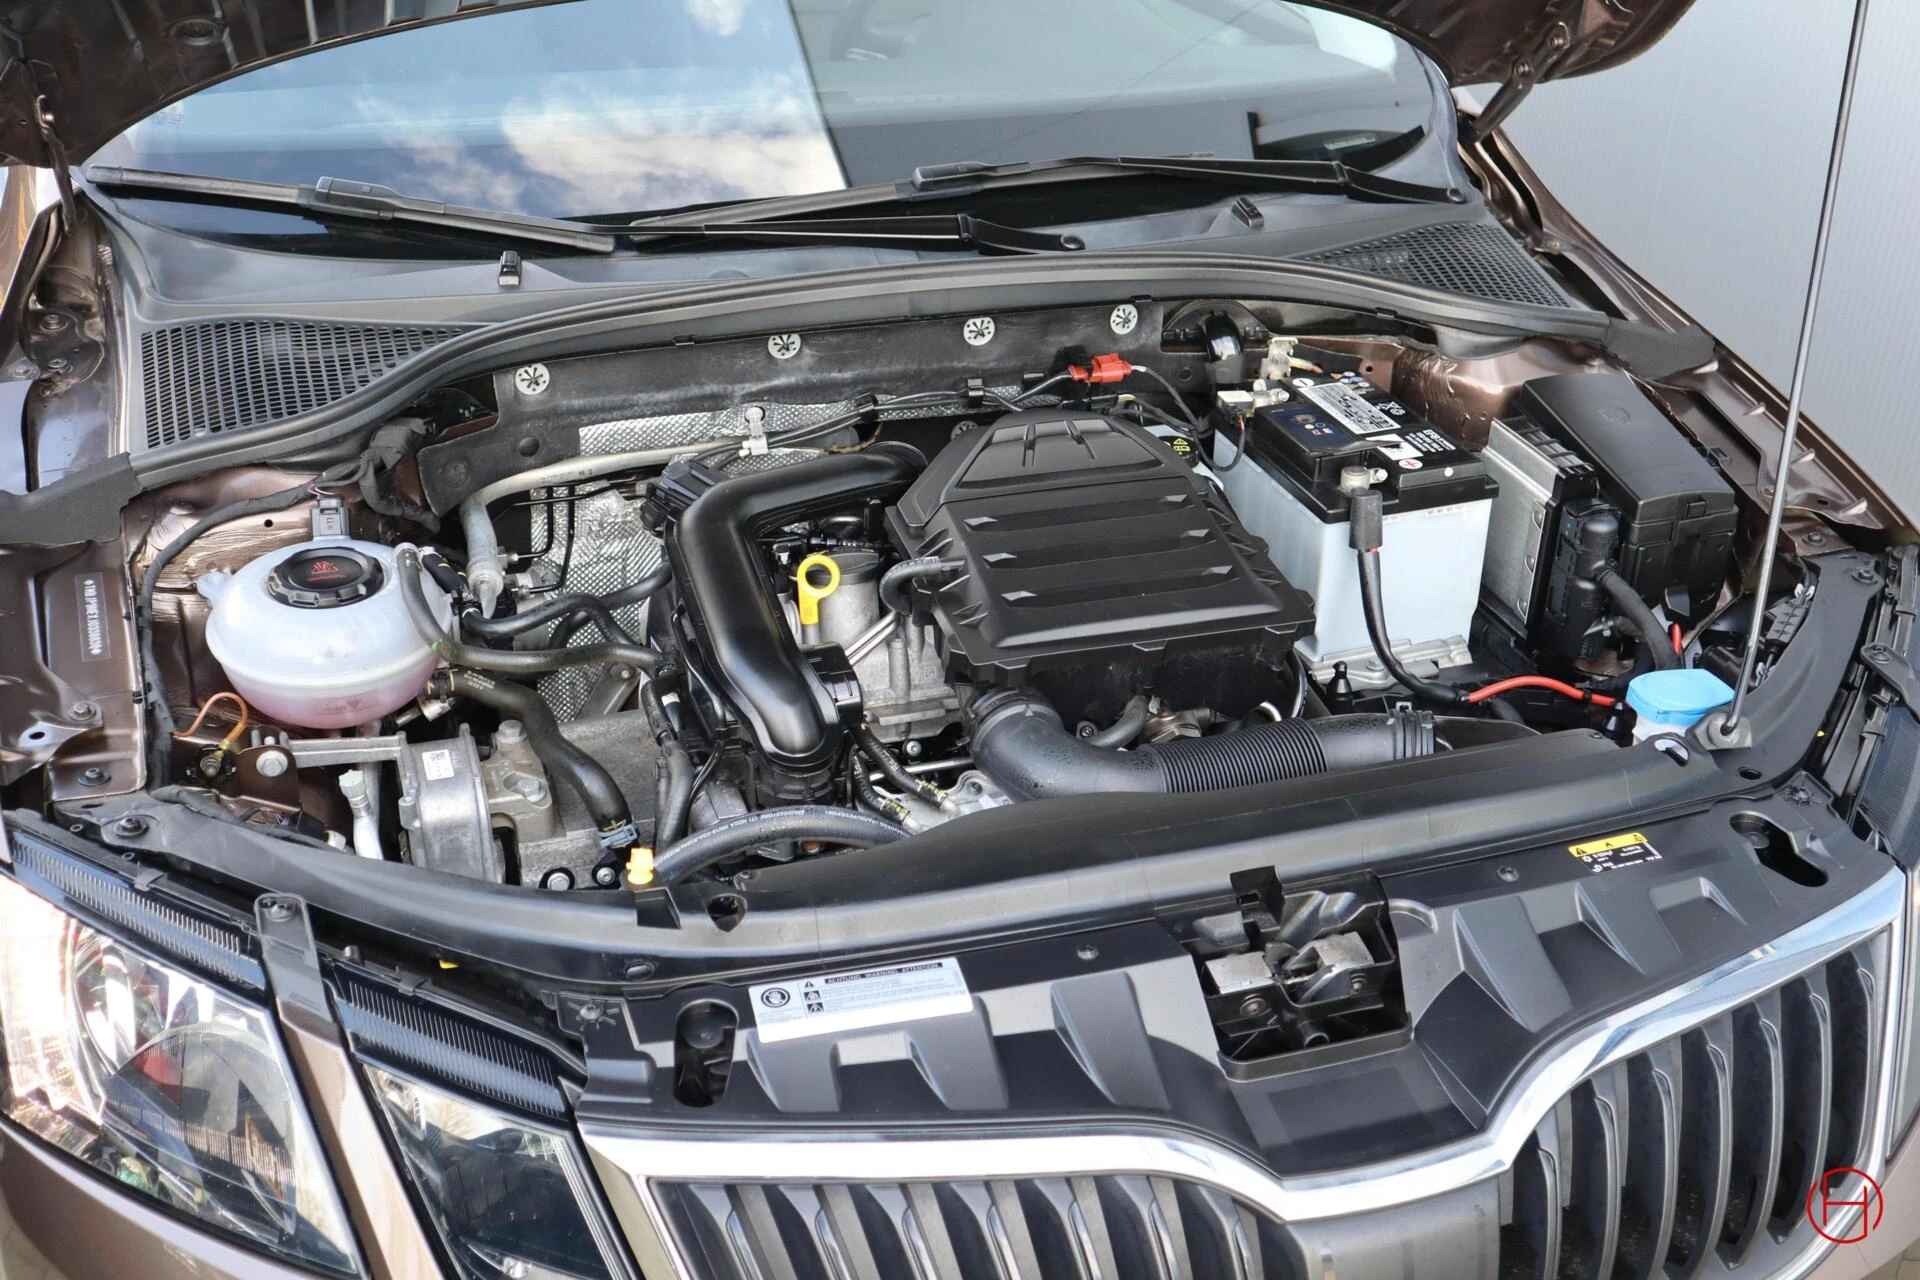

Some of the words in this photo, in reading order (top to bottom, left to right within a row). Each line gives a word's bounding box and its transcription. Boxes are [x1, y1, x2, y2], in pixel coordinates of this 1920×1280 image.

[828, 974, 861, 984] ACHTUNG
[865, 969, 899, 979] WARNING
[901, 963, 939, 973] ATTENTION
